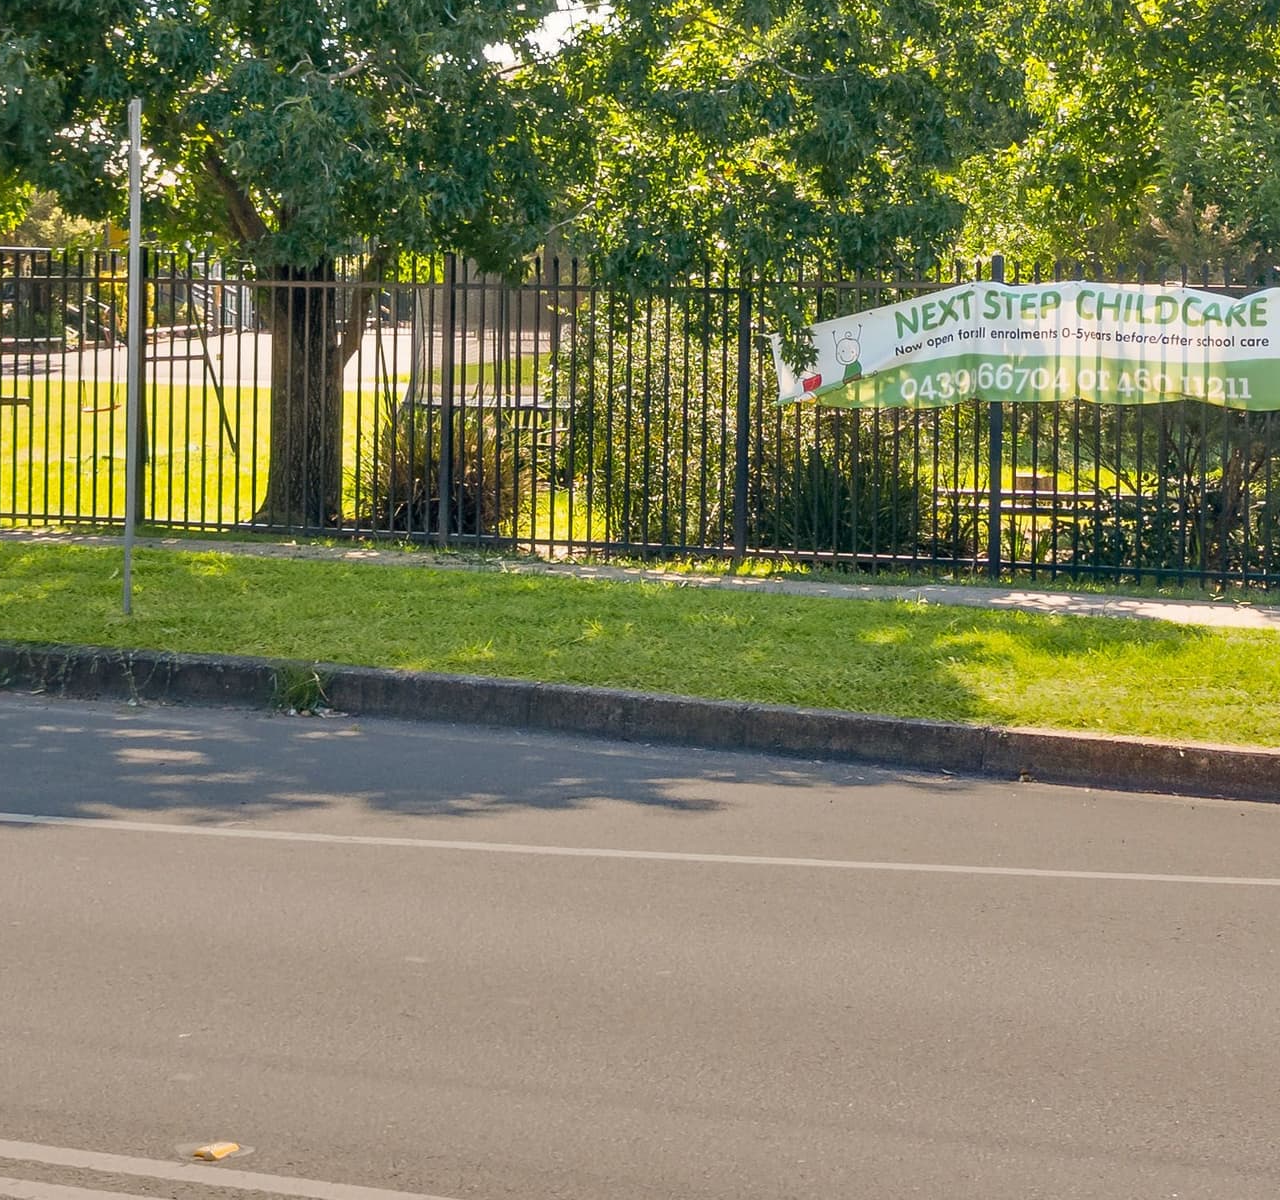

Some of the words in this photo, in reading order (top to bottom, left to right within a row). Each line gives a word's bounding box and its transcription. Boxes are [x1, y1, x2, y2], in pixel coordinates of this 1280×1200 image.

[894, 290, 975, 339] NEXT
[983, 290, 1062, 320] STEP
[1076, 290, 1268, 327] CHILDCARE
[895, 341, 923, 356] Now
[927, 333, 954, 348] open
[958, 329, 975, 340] for
[990, 328, 1058, 340] enrolments
[1115, 331, 1193, 346] before/after
[1196, 335, 1235, 347] school
[1240, 338, 1270, 347] care
[1077, 369, 1110, 392] or
